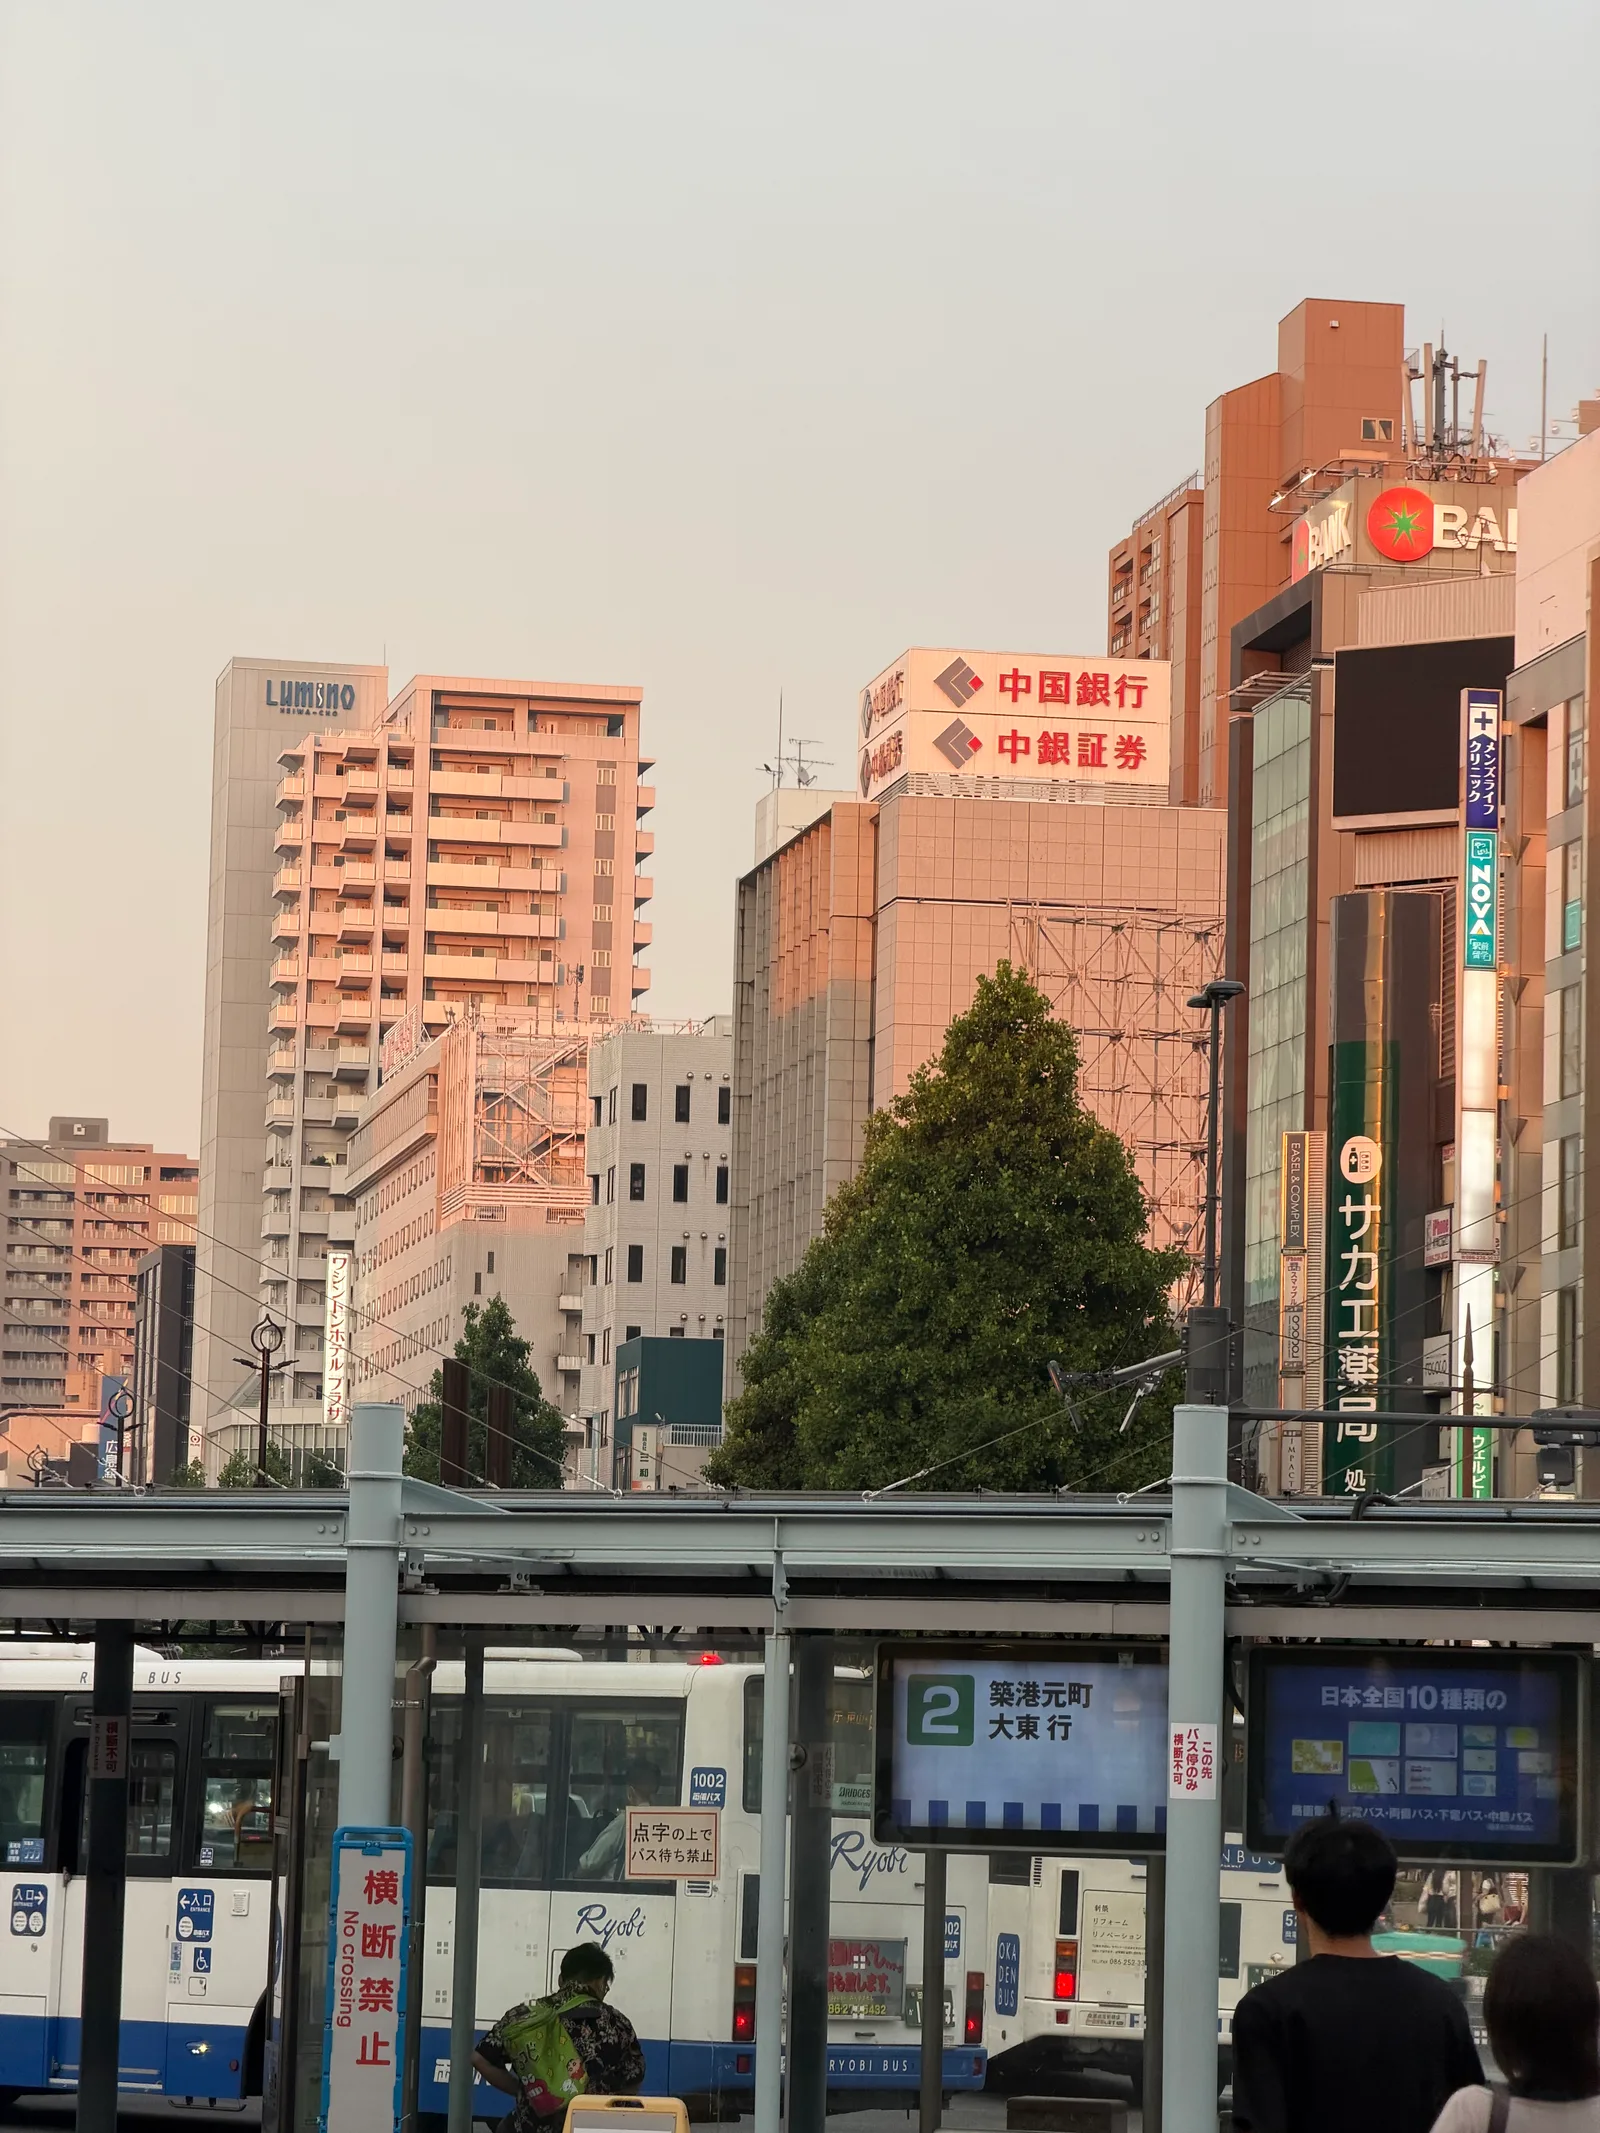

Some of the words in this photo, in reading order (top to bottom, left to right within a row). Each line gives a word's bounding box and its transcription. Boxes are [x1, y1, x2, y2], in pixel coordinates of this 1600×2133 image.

[1309, 502, 1352, 571] BANK
[999, 668, 1148, 708] 中国銀行
[998, 729, 1147, 769] 中銀証券
[1468, 741, 1481, 803] クリニック
[1483, 741, 1496, 816] メンズライフ
[1470, 864, 1492, 936] NOVA
[1290, 1142, 1301, 1175] EASEL
[1291, 1175, 1300, 1184] &
[1290, 1184, 1300, 1238] COMPLEX
[329, 1257, 347, 1372] ワシントンホテル
[1337, 1193, 1382, 1444] サカエ薬局
[327, 1376, 344, 1421] プラザ
[1287, 1438, 1296, 1488] IMPACT
[148, 1671, 181, 1684] BUS
[989, 1680, 1093, 1708] 築港元町
[922, 1685, 960, 1734] 2
[1321, 1685, 1508, 1711] 日本全国10種類の
[1173, 1733, 1184, 1785] 横断不可
[1186, 1728, 1199, 1791] バス停のみ
[1201, 1742, 1213, 1779] この先
[692, 1773, 725, 1788] 1002
[633, 1822, 713, 1843] 点字の上で
[14, 1888, 34, 1901] 入口
[190, 1893, 211, 1906] 入口
[343, 1911, 359, 1936] No
[576, 1904, 645, 1949] Ryobi
[1092, 1931, 1142, 1940] リノベーション
[1093, 1917, 1129, 1926] リフォーム
[355, 1869, 399, 2066] 横断禁止
[998, 1942, 1017, 1961] OKA
[336, 1943, 355, 2028] crossing
[998, 1965, 1017, 1984] DEN
[998, 1988, 1015, 2008] BUS
[829, 2060, 872, 2071] RYOBI
[882, 2060, 908, 2071] BUS
